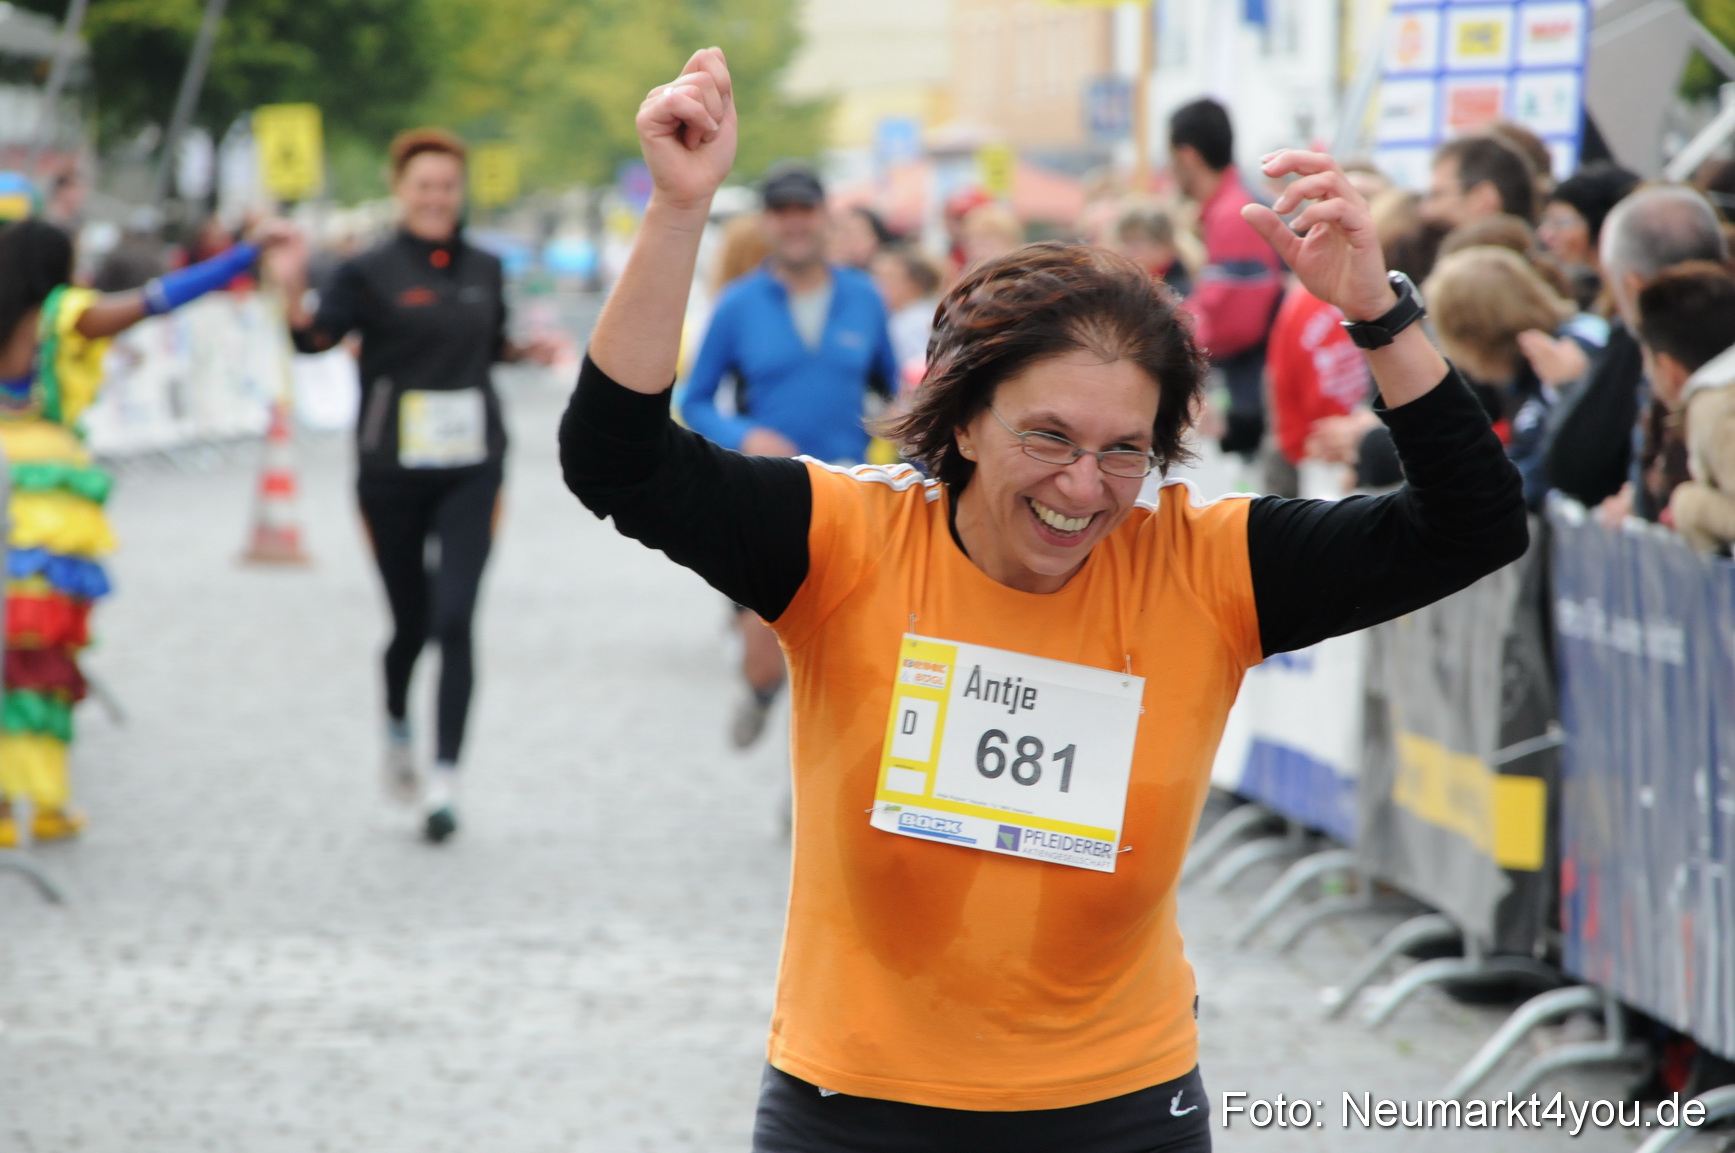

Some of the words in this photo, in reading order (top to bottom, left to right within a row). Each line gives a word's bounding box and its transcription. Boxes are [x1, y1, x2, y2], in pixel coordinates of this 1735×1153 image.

[963, 664, 1038, 714] Antje
[902, 709, 918, 735] D
[976, 728, 1077, 793] 681
[899, 812, 963, 834] BOCK
[1024, 829, 1113, 859] PFLEIDERER
